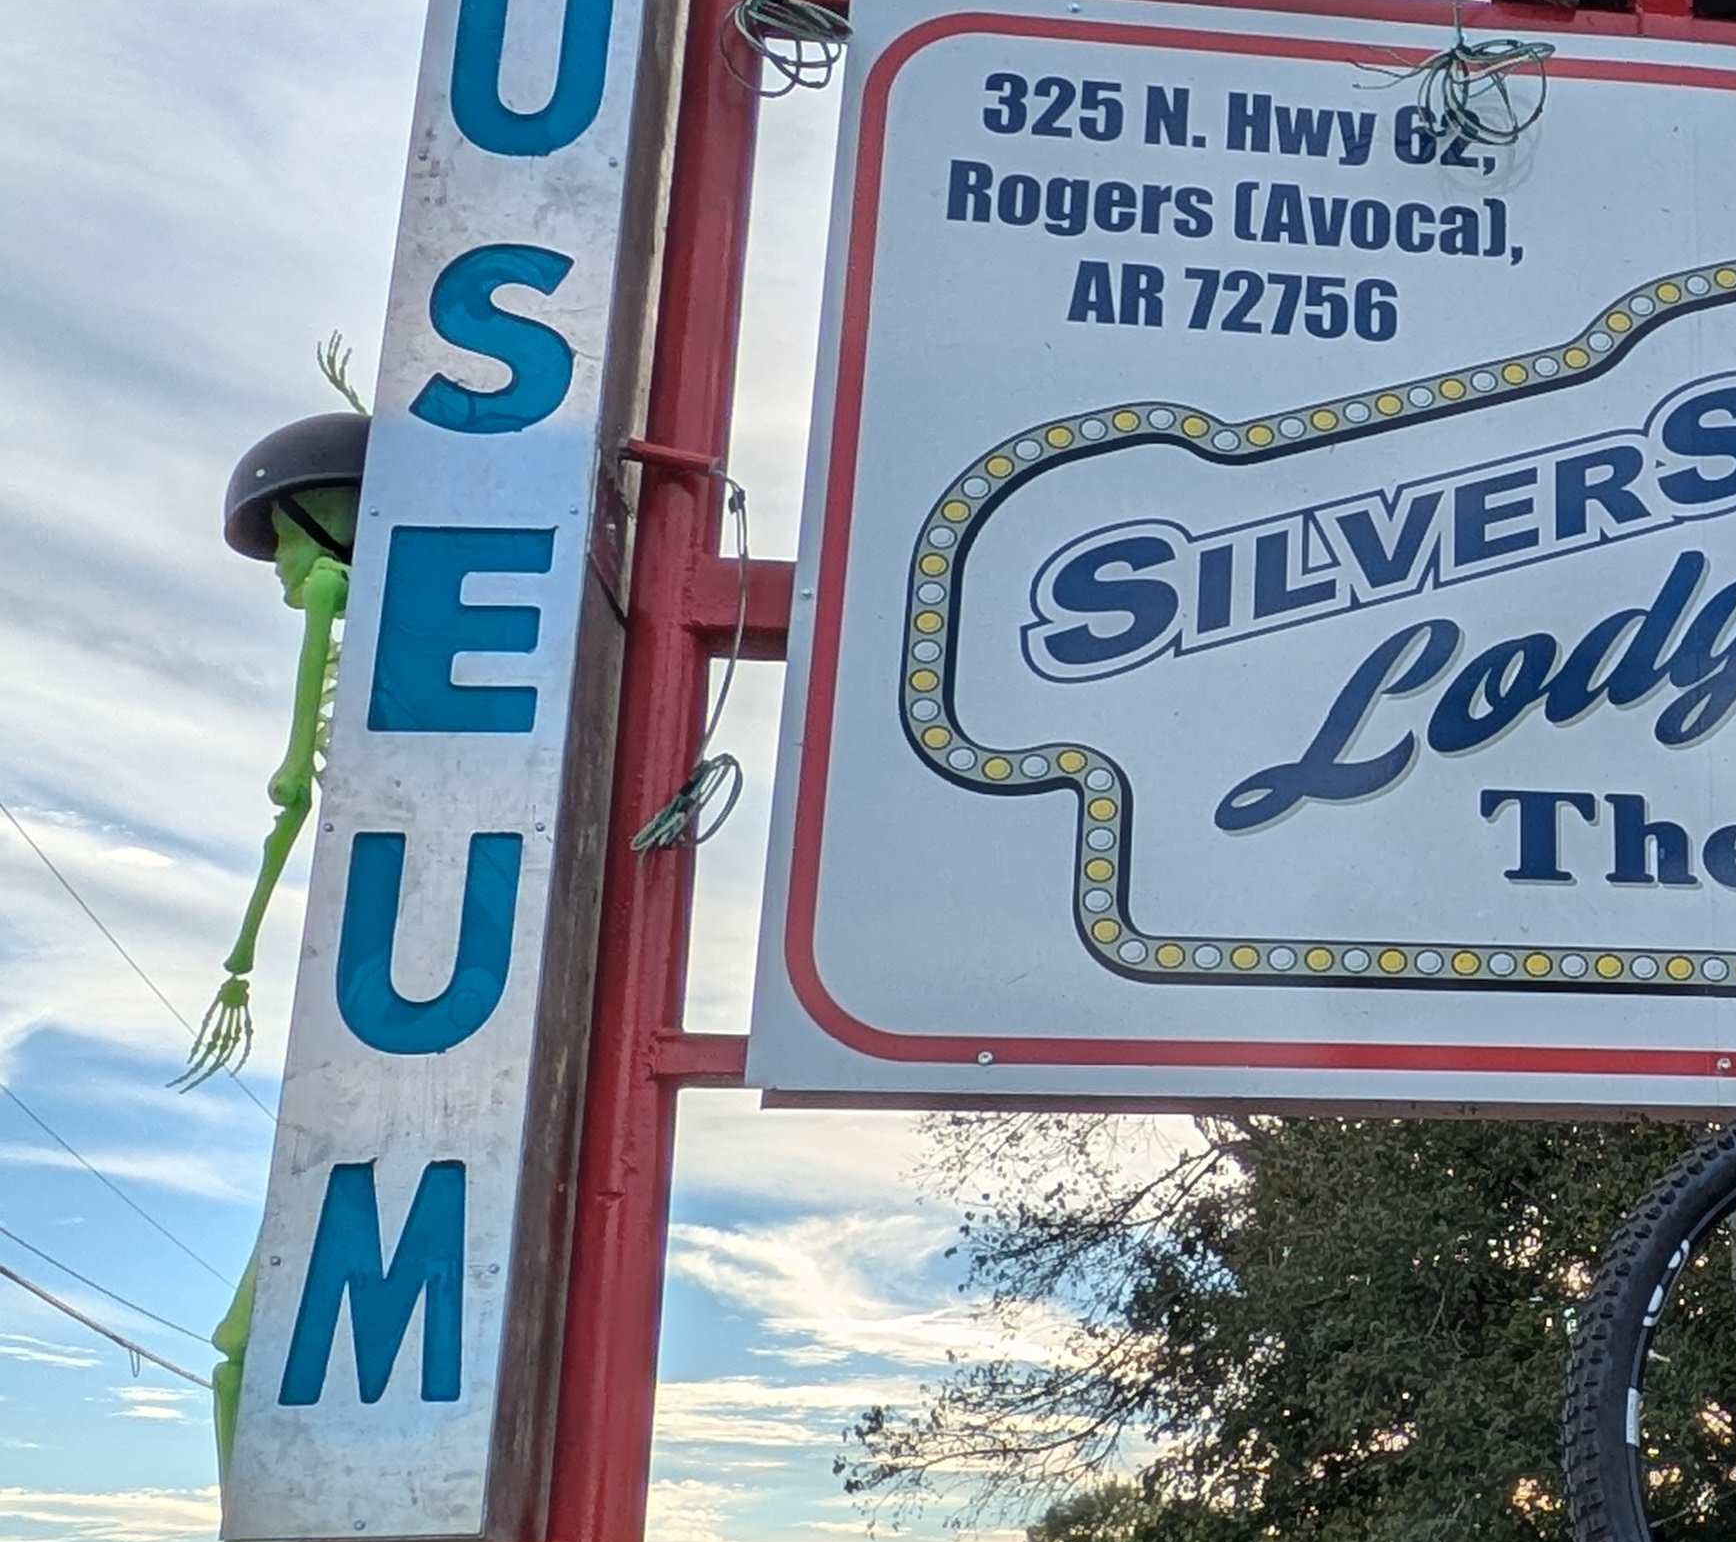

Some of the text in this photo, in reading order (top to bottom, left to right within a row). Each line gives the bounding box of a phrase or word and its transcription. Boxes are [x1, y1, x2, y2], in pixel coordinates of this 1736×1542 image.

[983, 72, 1124, 142] 325
[1144, 85, 1206, 149] N.
[1226, 91, 1377, 166] Hwy
[946, 159, 1214, 239] Rogers
[1067, 260, 1399, 342] AR 72756
